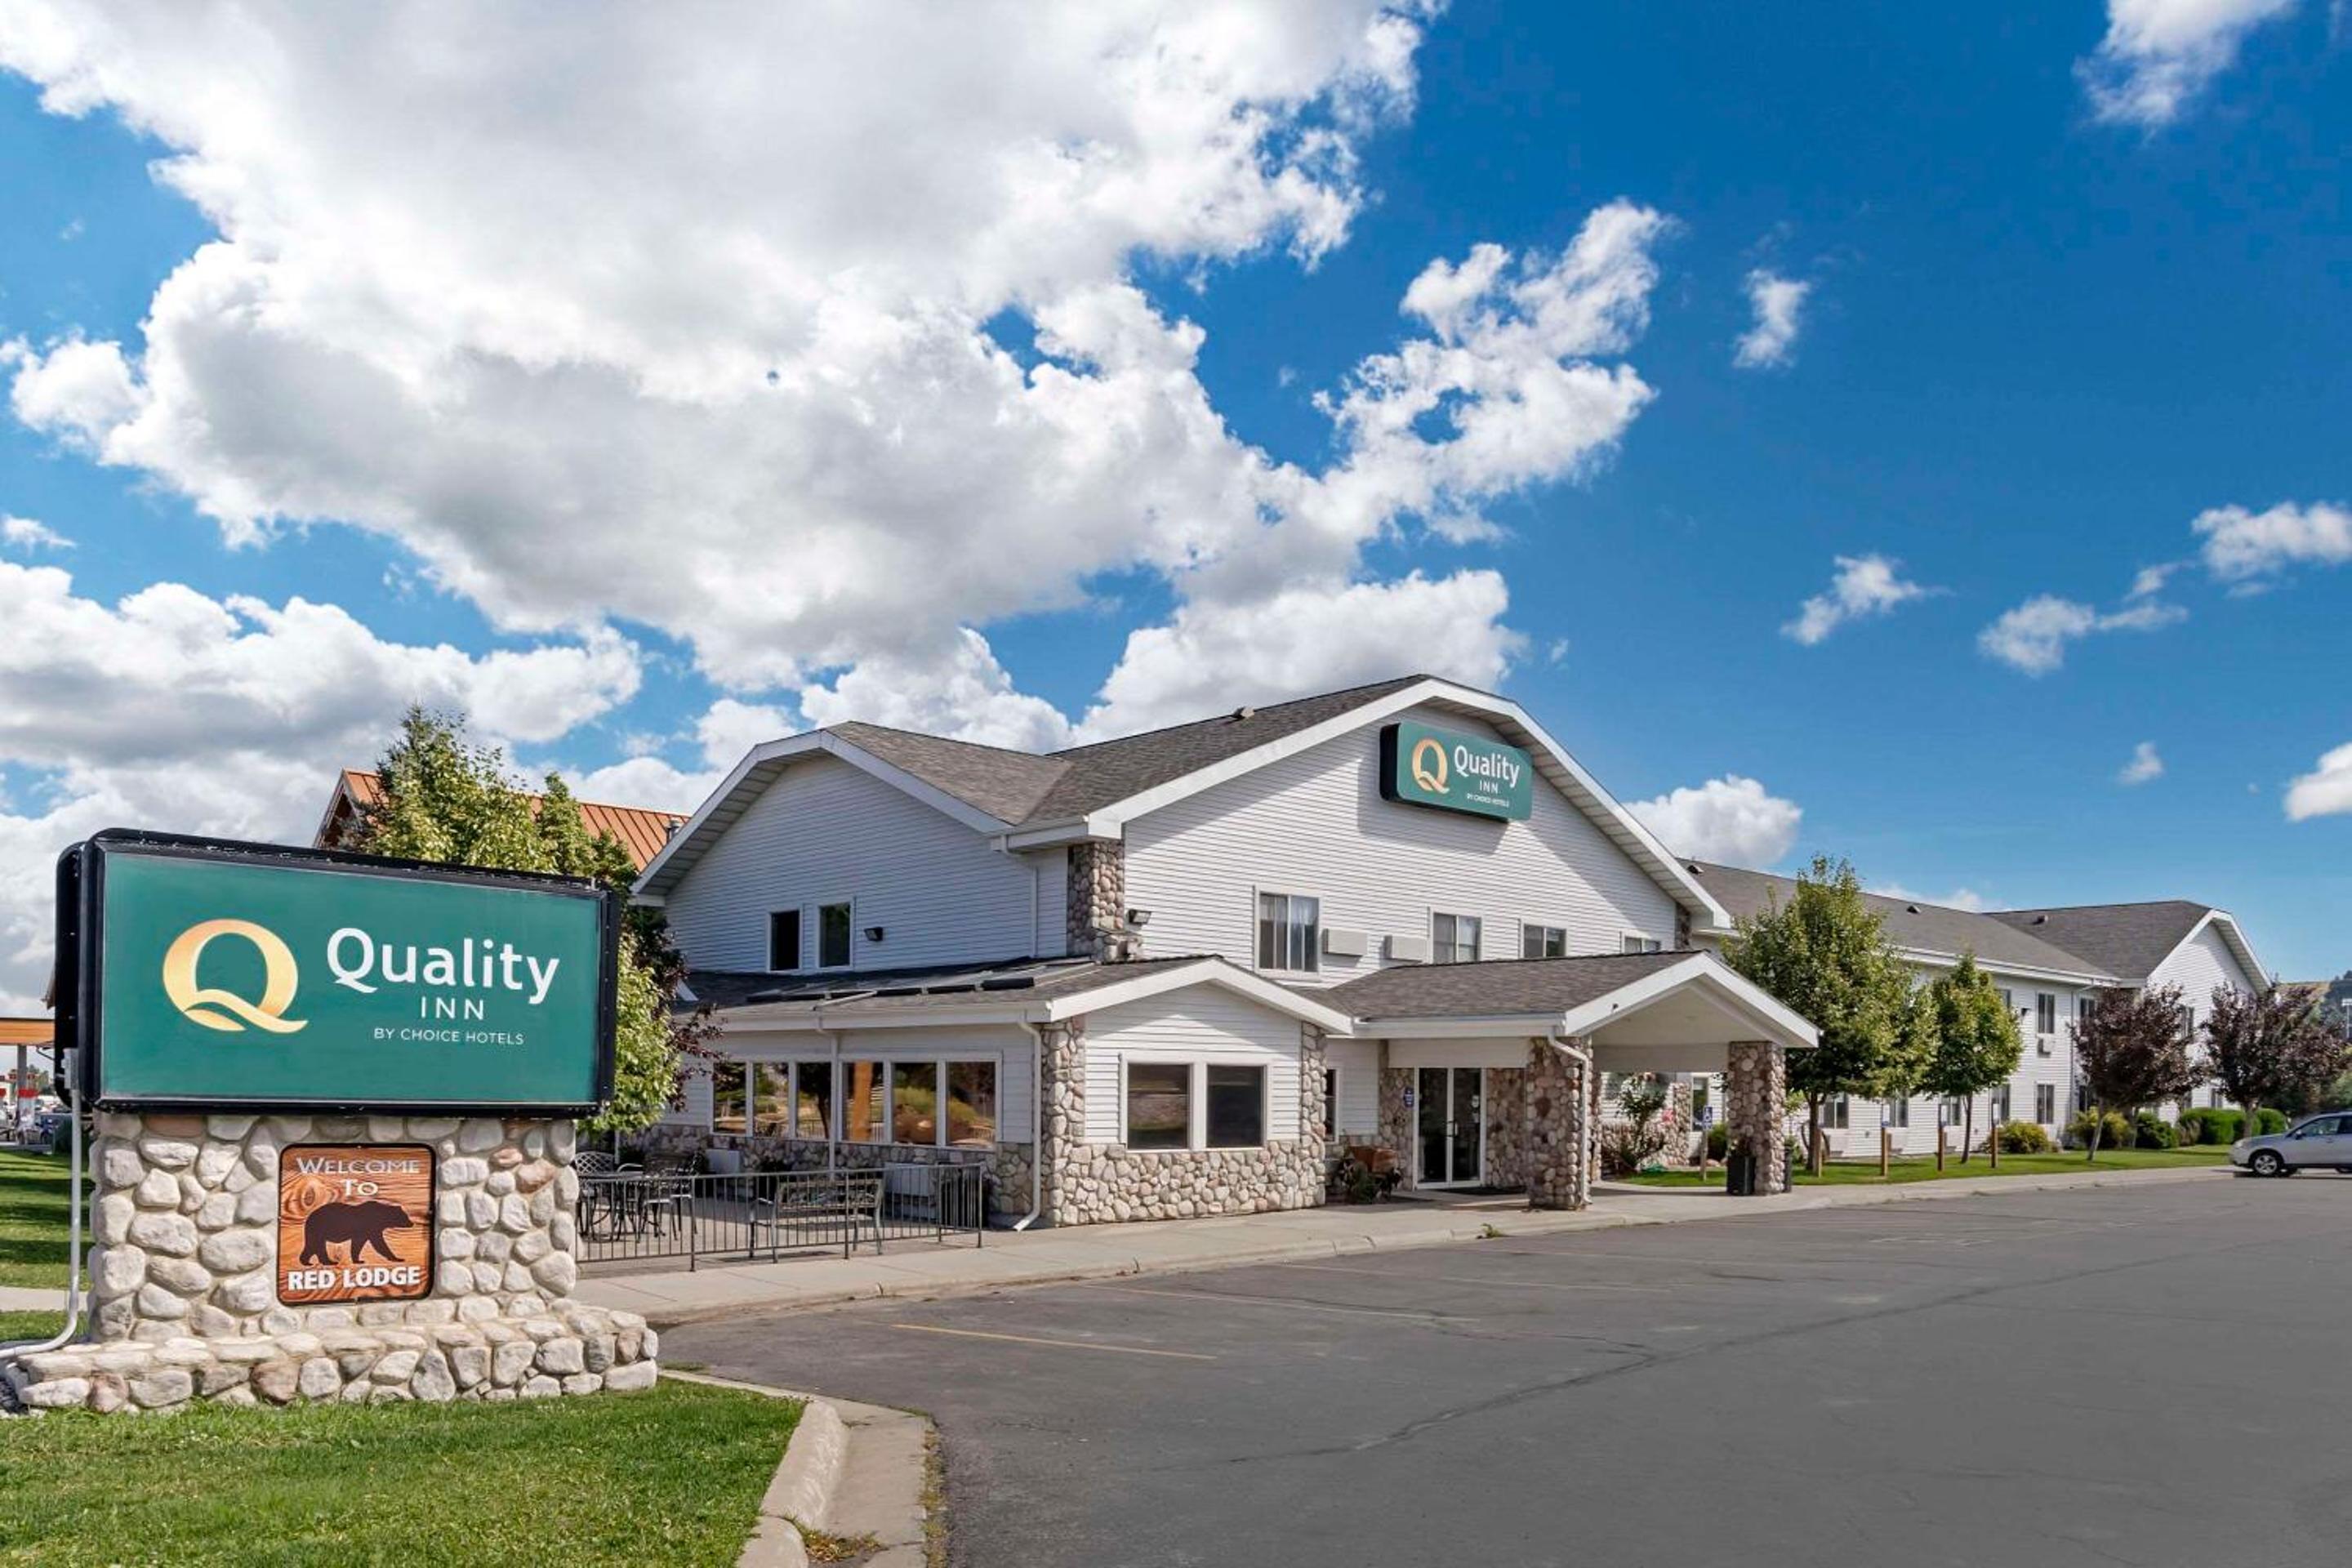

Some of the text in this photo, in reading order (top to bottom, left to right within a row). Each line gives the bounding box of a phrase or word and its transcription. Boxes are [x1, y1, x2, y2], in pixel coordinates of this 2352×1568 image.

[1413, 739, 1450, 794] Q
[1454, 745, 1520, 788] Quality
[1479, 780, 1499, 794] INN
[163, 919, 308, 1034] Q
[327, 928, 559, 1004] Quality
[421, 996, 484, 1021] INN
[374, 1027, 524, 1045] BY CHOICE HOTELS
[287, 1267, 421, 1291] RED LODGE
